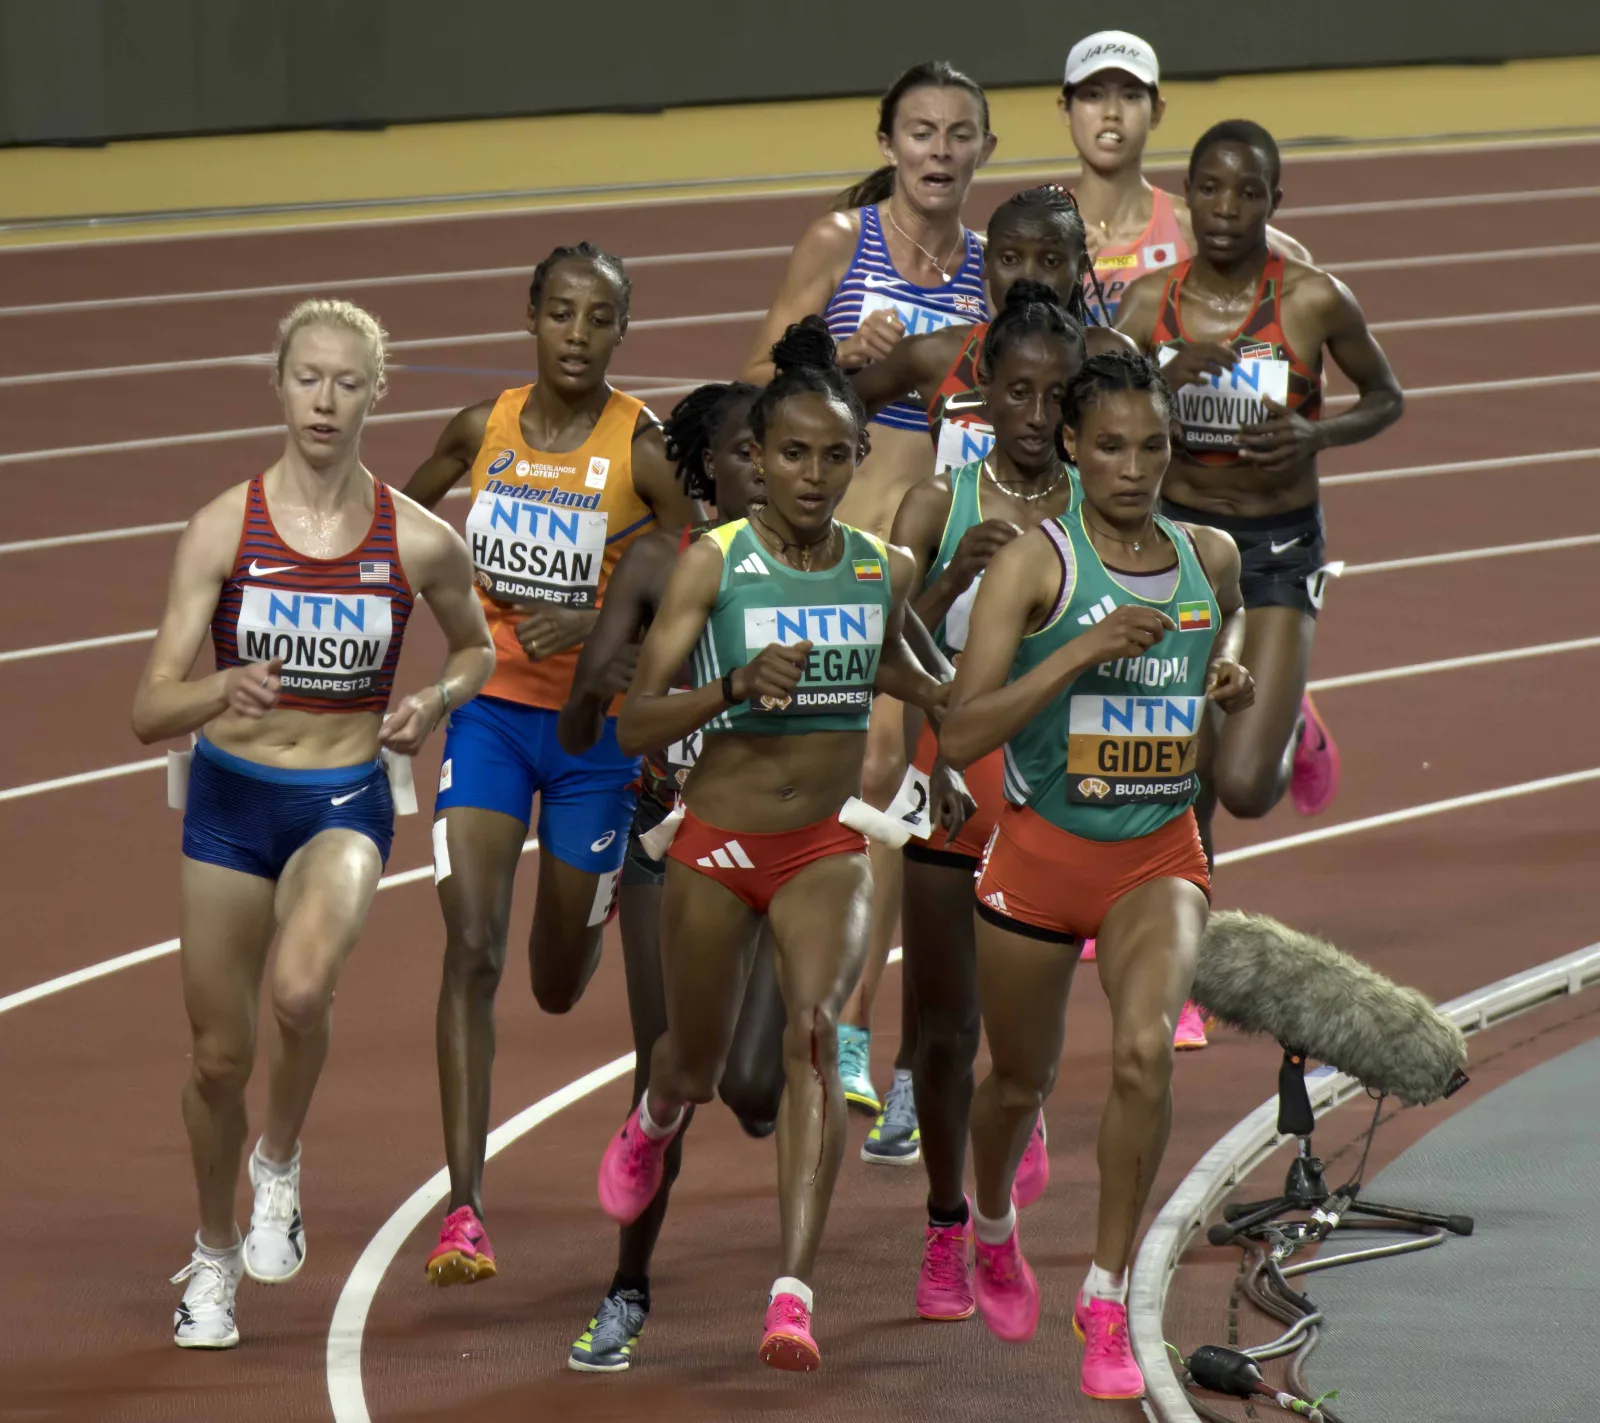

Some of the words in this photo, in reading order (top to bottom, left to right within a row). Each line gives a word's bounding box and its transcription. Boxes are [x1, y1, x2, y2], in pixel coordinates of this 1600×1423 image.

[1082, 43, 1141, 63] JAPAN
[893, 303, 953, 336] NT
[1187, 431, 1233, 444] BUDAP
[530, 463, 576, 475] NEDERLANDSE
[490, 497, 579, 546] NTN
[472, 532, 593, 582] HASSAN
[268, 592, 365, 633] NTN
[776, 606, 867, 644] NTN
[246, 630, 380, 671] MONSON
[805, 648, 876, 682] EGAY
[1097, 655, 1189, 687] ETHIOPIA
[1101, 697, 1196, 734] NTN
[1098, 739, 1192, 773] GIDEY
